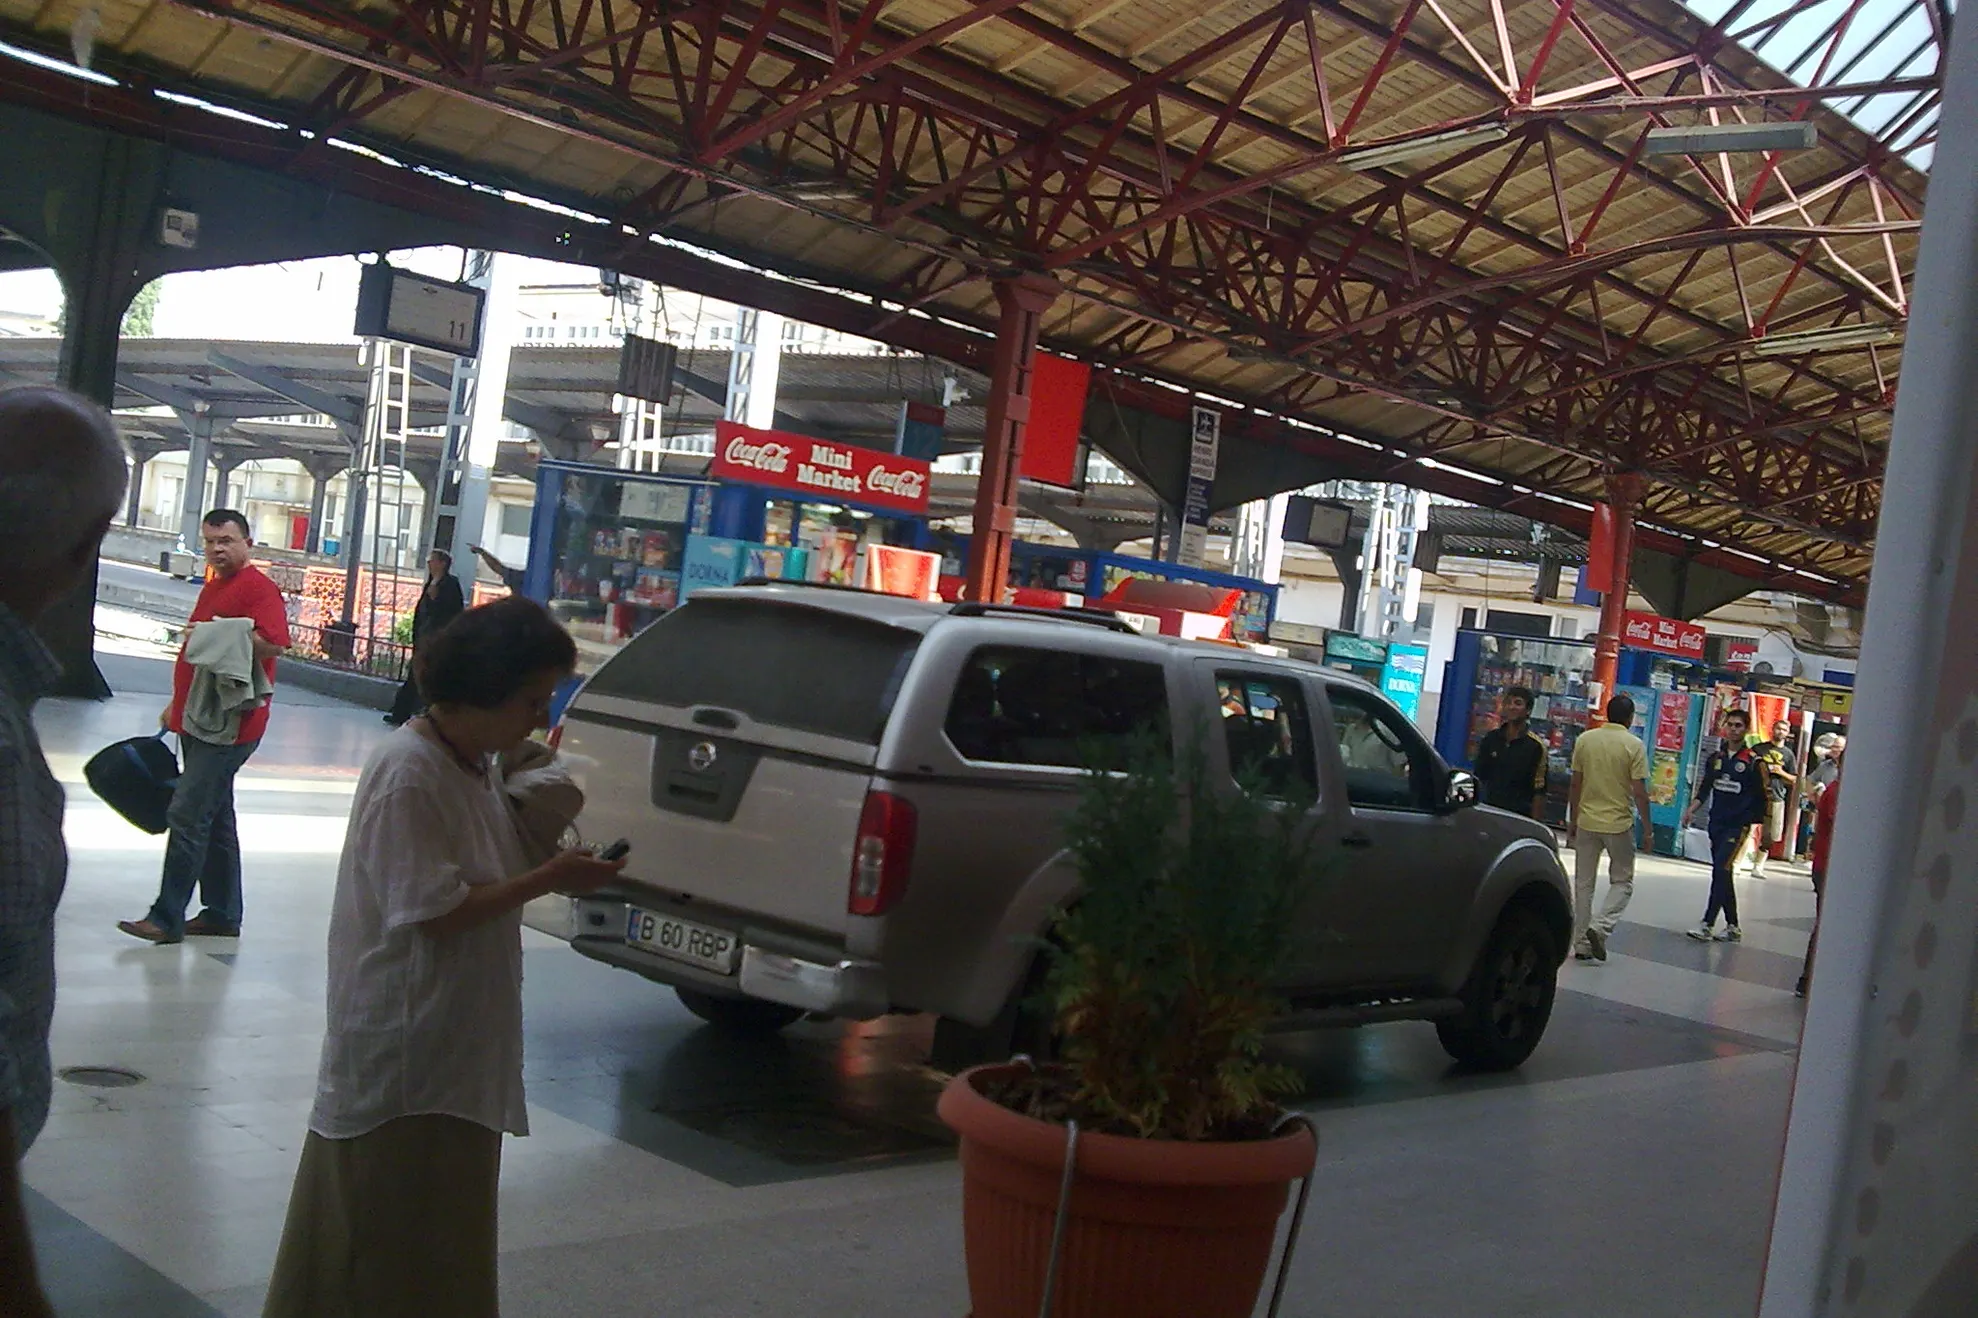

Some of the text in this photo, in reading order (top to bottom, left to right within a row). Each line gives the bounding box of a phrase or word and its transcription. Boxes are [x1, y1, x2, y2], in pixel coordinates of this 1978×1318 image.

[449, 321, 465, 341] 11
[811, 444, 853, 470] Mini
[797, 463, 861, 493] Market
[1660, 622, 1676, 634] Mini
[1654, 634, 1677, 649] Market
[642, 916, 654, 940] B
[662, 922, 682, 948] 60
[688, 929, 728, 960] RBP
